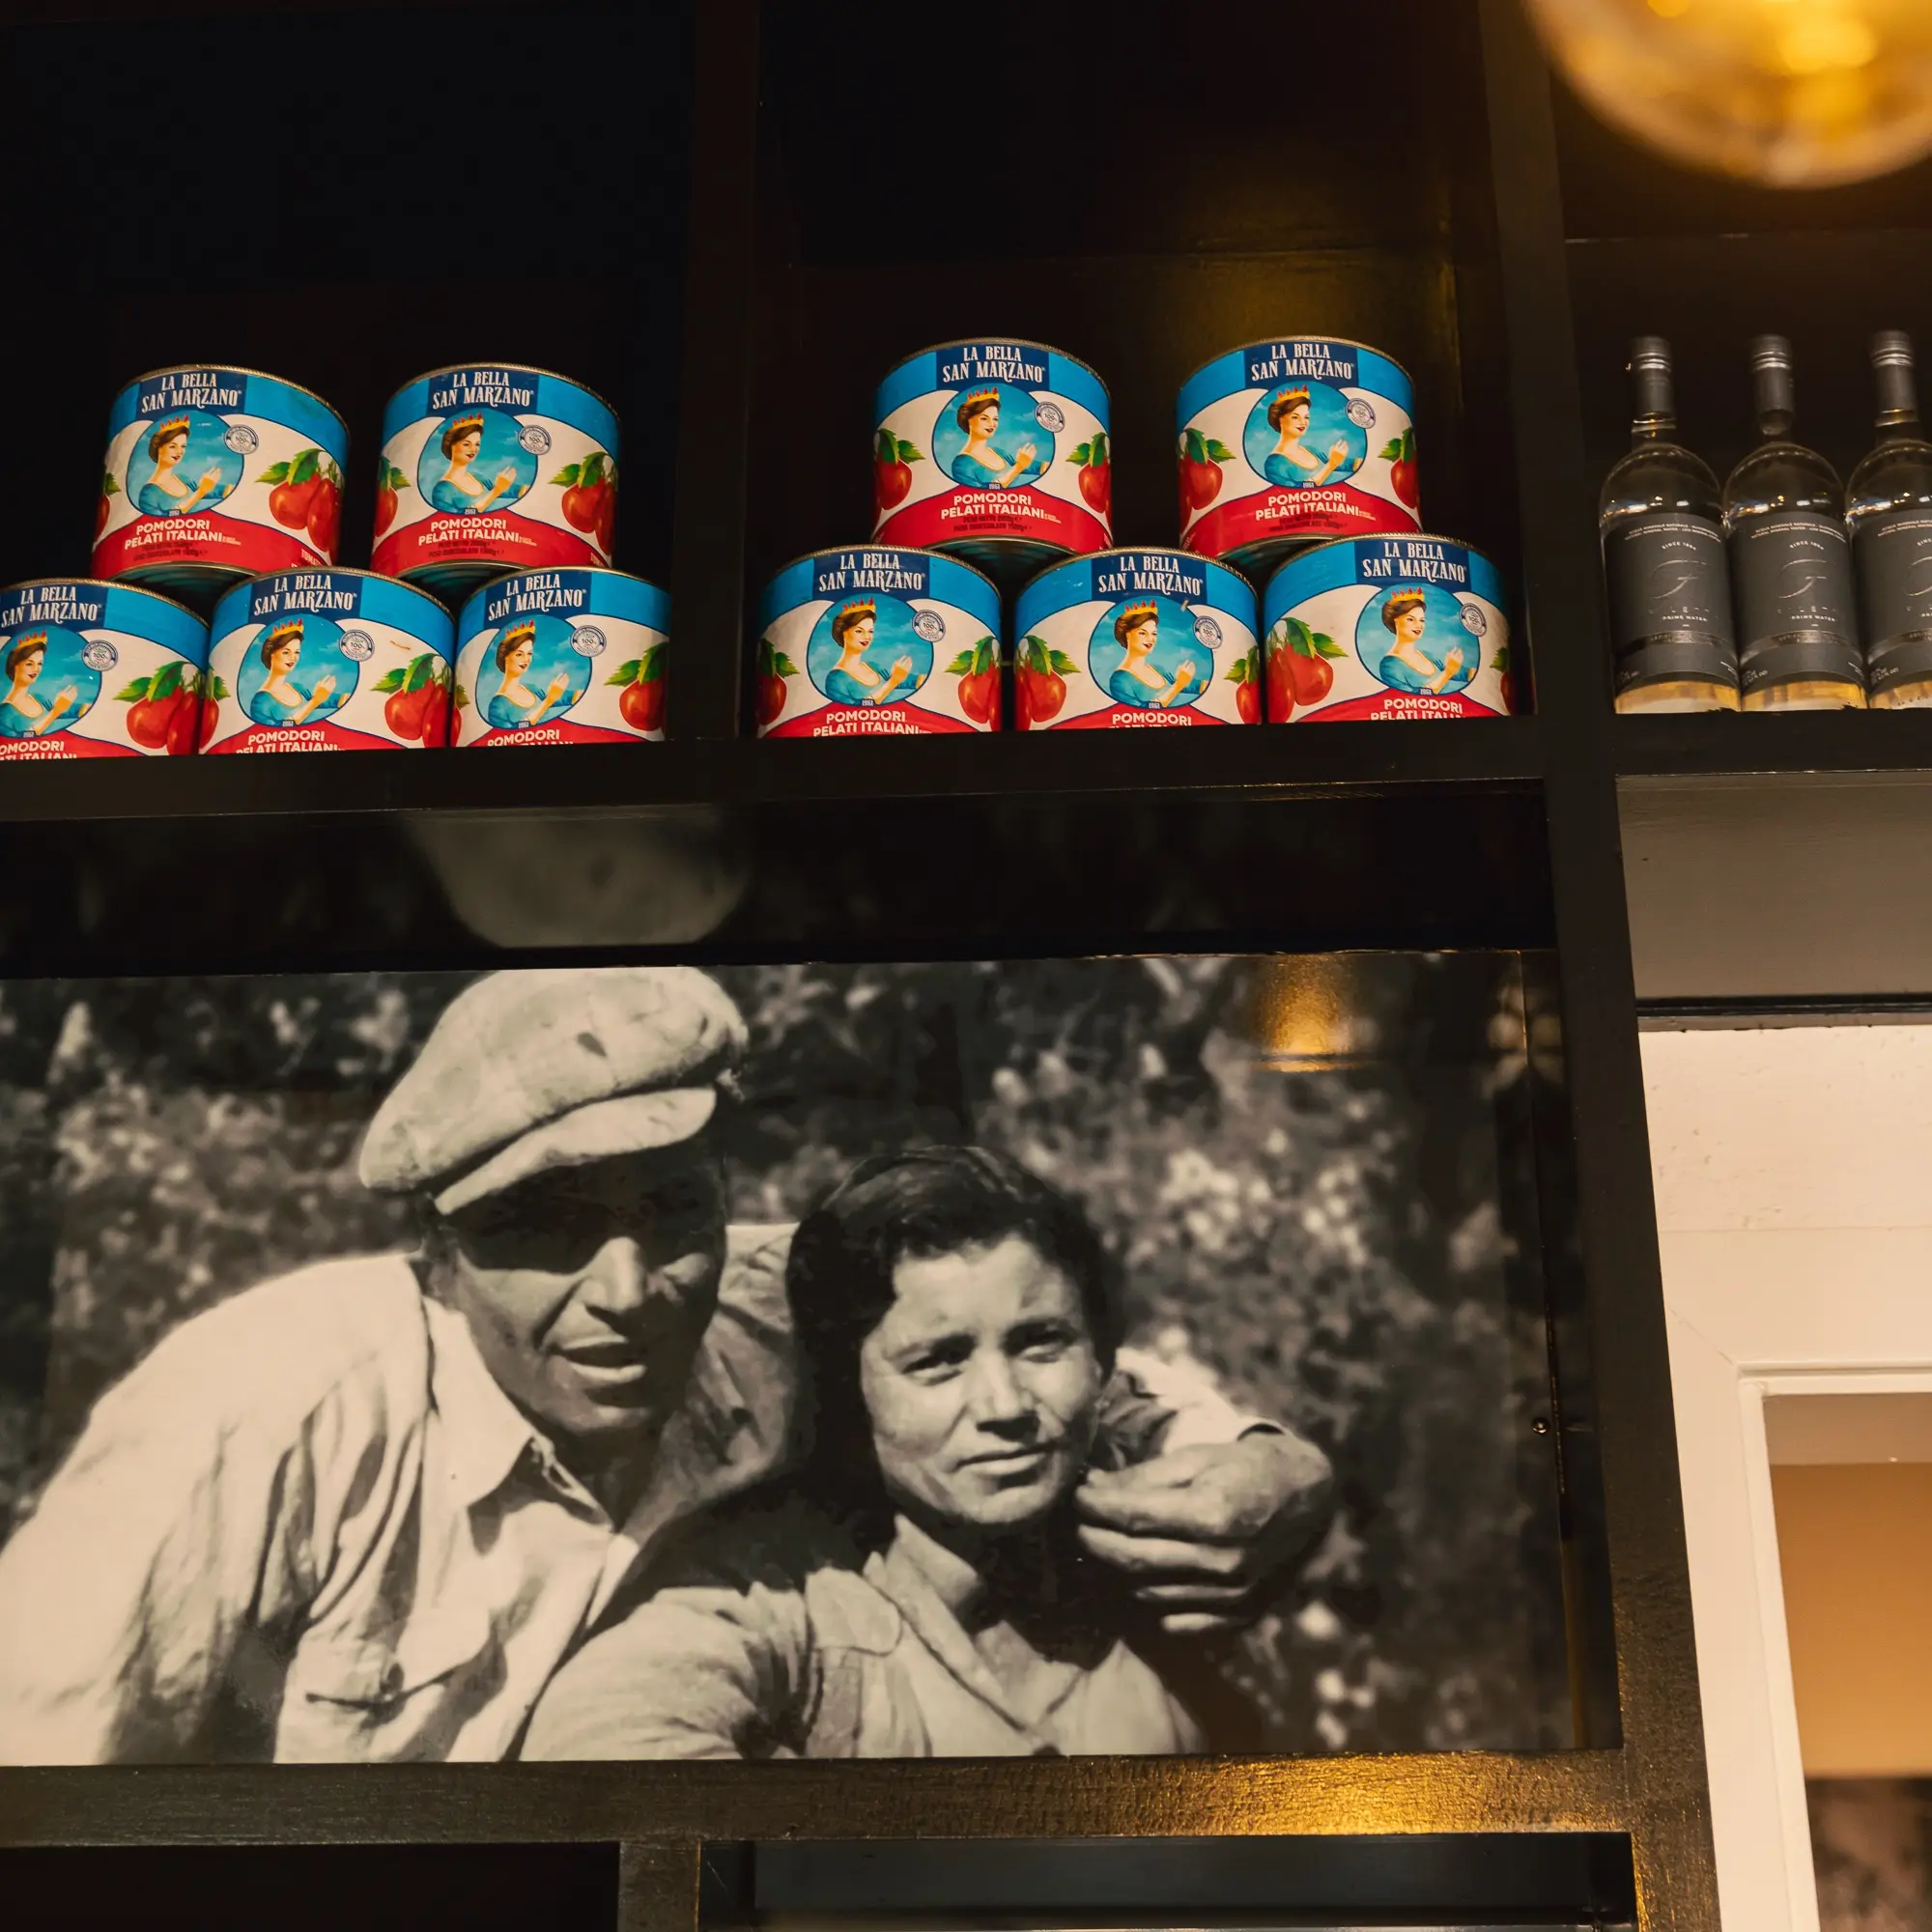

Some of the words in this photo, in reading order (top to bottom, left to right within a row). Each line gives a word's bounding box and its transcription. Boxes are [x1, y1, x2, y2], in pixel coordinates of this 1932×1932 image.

[963, 347, 979, 361] LA
[985, 346, 1022, 361] BELLA
[1271, 345, 1287, 359] LA
[1293, 344, 1330, 359] BELLA
[942, 362, 969, 384] SAN
[1251, 359, 1279, 382] SAN
[162, 377, 175, 391] LA
[182, 373, 216, 388] BELLA
[453, 374, 467, 388] LA
[474, 372, 509, 386] BELLA
[142, 392, 166, 413] SAN
[433, 388, 457, 410] SAN
[953, 493, 1032, 505] POMODORI
[1268, 491, 1346, 505] POMODORI
[941, 504, 985, 520] PELATI
[988, 504, 1044, 519] ITALIANI
[1256, 505, 1300, 521] PELATI
[1304, 503, 1359, 516] ITALIANI
[136, 519, 210, 536] POMODORI
[431, 518, 506, 532] POMODORI
[125, 533, 163, 550] PELATI
[166, 531, 222, 542] ITALIANI
[418, 530, 459, 547] PELATI
[463, 528, 520, 542] ITALIANI
[1384, 542, 1401, 557] LA
[1407, 542, 1444, 560] BELLA
[840, 555, 855, 569] LA
[864, 554, 899, 569] BELLA
[1121, 556, 1135, 572] LA
[1144, 556, 1179, 573] BELLA
[1362, 559, 1392, 578] SAN
[274, 578, 288, 593] LA
[295, 575, 331, 590] BELLA
[506, 582, 520, 596] LA
[526, 574, 560, 591] BELLA
[819, 572, 845, 592] SAN
[1098, 574, 1126, 593] SAN
[20, 590, 35, 605] LA
[41, 586, 76, 602] BELLA
[254, 595, 279, 616] SAN
[488, 598, 510, 621] SAN
[1, 607, 24, 628] SAN
[1371, 710, 1418, 721] PELATI
[1384, 698, 1463, 715] POMODORI
[826, 710, 905, 724] POMODORI
[1113, 712, 1192, 726] POMODORI
[247, 729, 325, 745] POMODORI
[487, 729, 560, 747] POMODORI
[813, 723, 857, 737] PELATI
[862, 722, 920, 734] ITALIANI
[0, 740, 65, 754] OMODORI
[279, 742, 338, 753] ITALIANI
